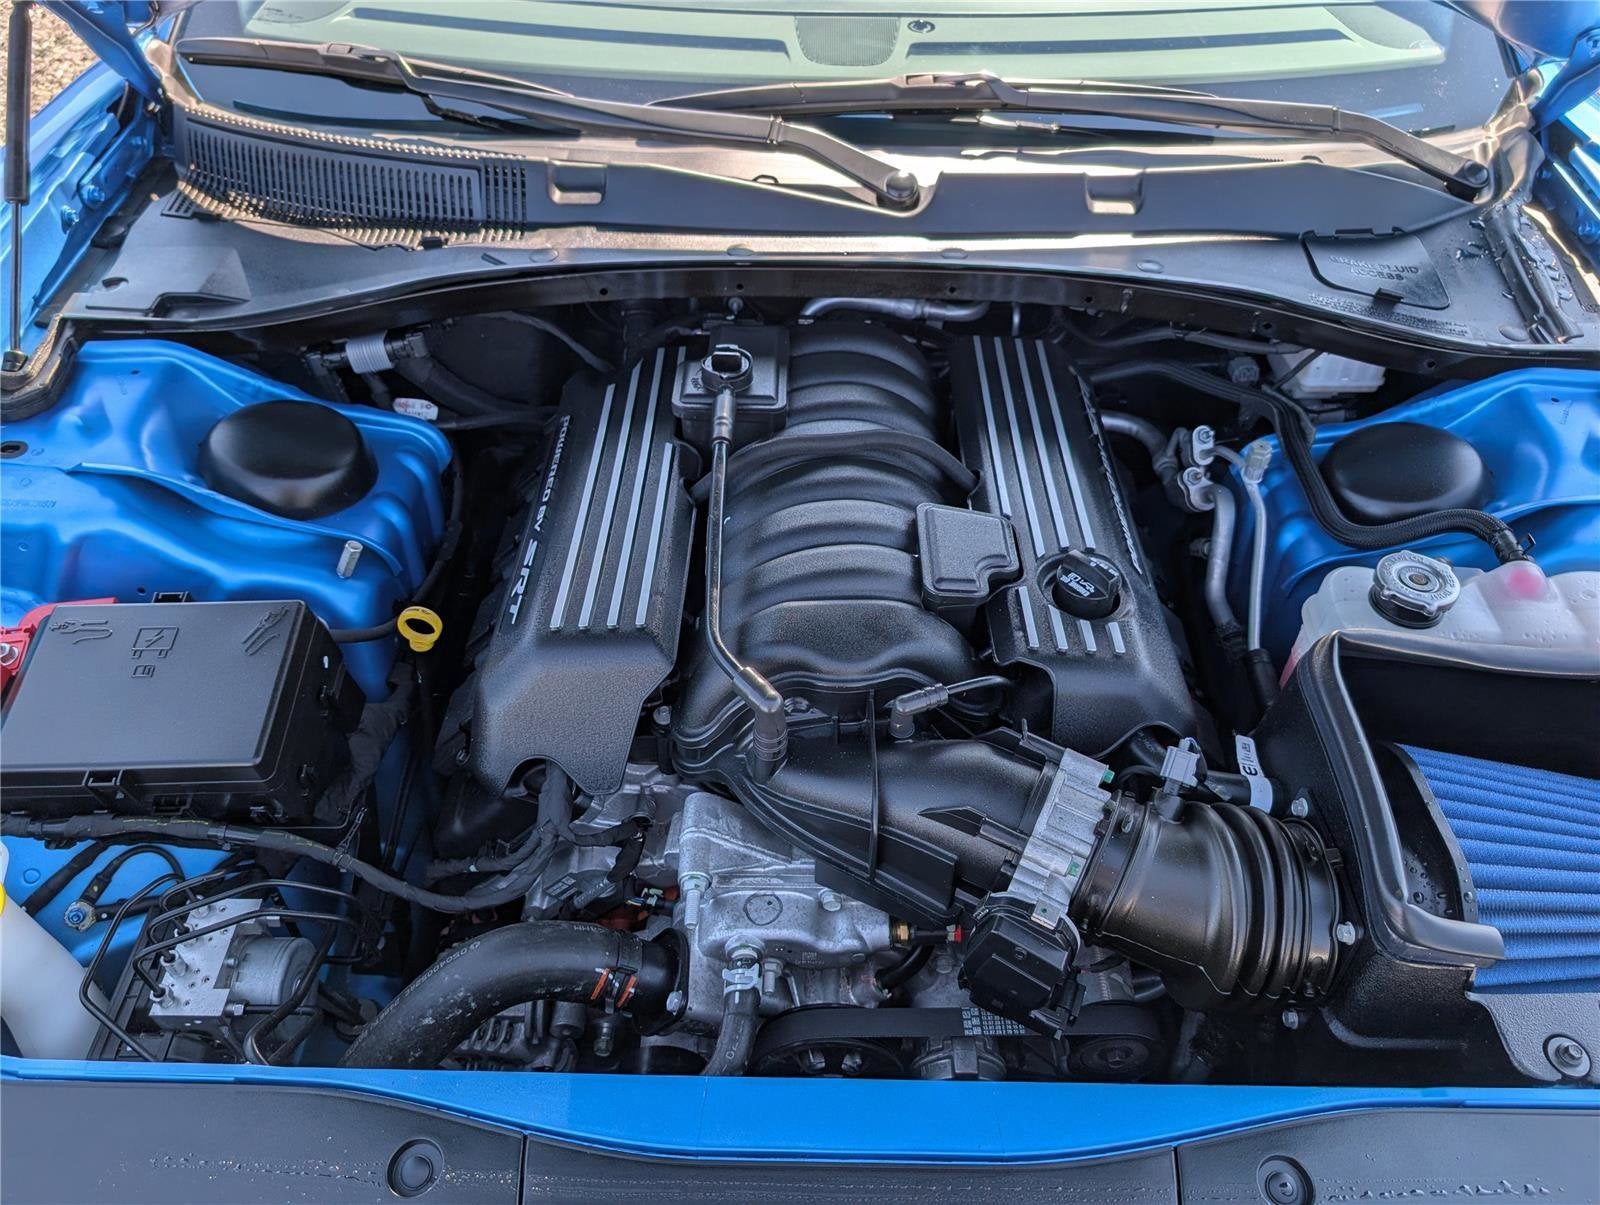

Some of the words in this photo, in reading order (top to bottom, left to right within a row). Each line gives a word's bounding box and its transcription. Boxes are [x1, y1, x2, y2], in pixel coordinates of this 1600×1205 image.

[542, 415, 571, 502] POWERED
[534, 505, 547, 532] BY
[509, 538, 538, 625] SRT
